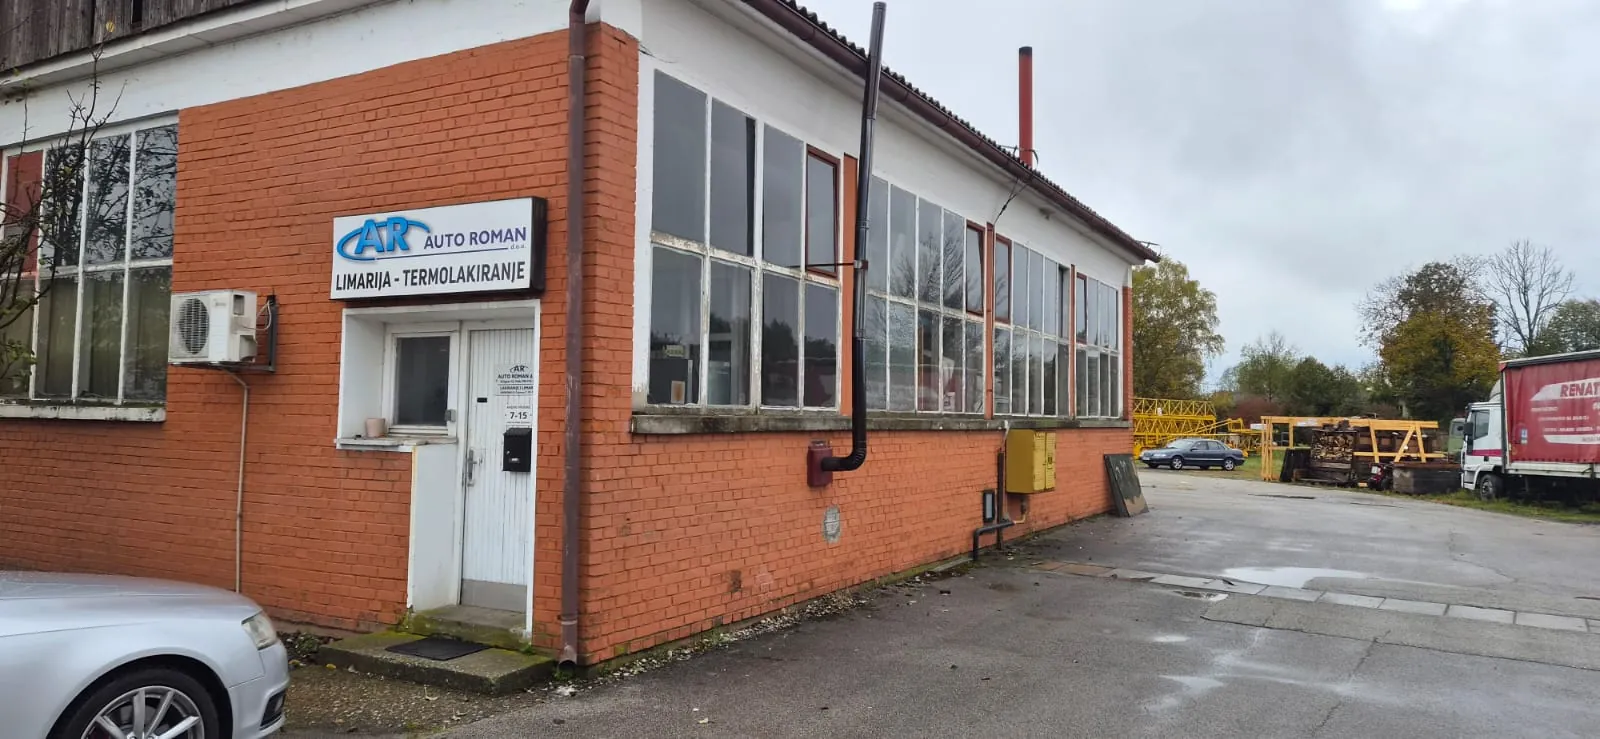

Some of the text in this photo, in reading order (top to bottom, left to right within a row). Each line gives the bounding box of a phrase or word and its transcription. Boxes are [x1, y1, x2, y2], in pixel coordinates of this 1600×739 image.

[354, 216, 410, 255] AR
[424, 226, 527, 250] AUTO ROMAN
[336, 271, 392, 291] LIMARIJA
[403, 261, 526, 287] TERMOLAKIRANJE
[509, 411, 528, 419] 7-15
